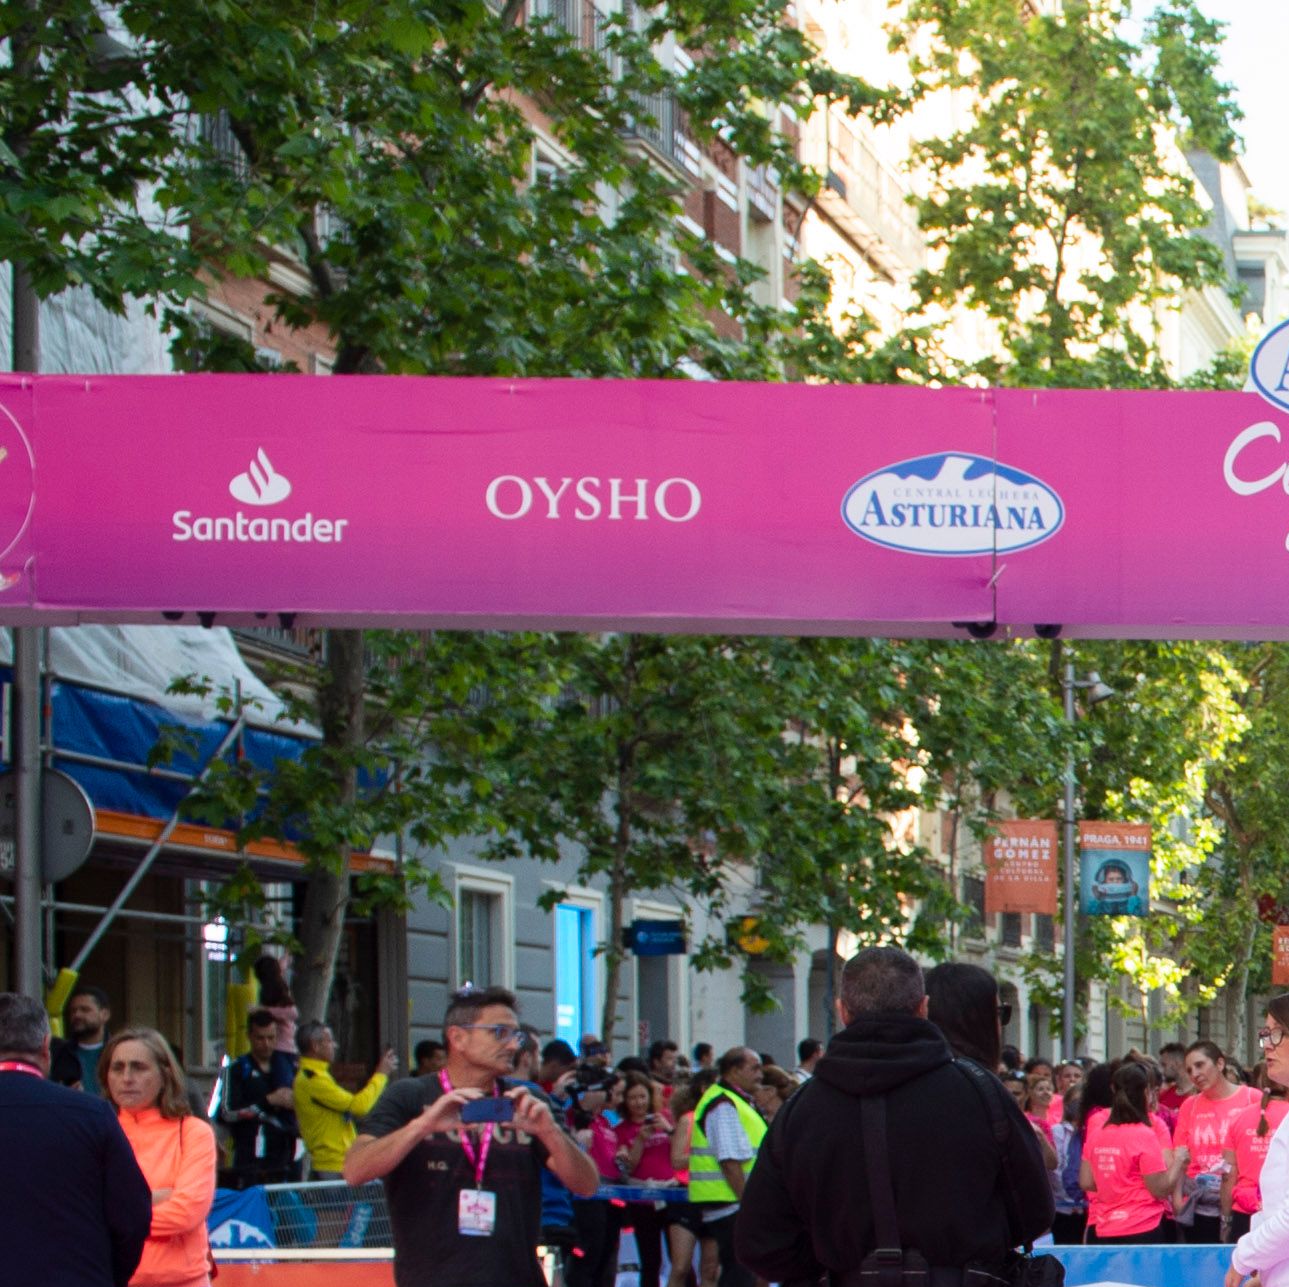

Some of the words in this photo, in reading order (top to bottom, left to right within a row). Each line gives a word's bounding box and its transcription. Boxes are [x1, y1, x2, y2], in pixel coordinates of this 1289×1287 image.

[485, 474, 702, 523] OYSHO
[860, 490, 1047, 530] ASTURIANA
[893, 487, 961, 498] CENTRAL
[968, 489, 1040, 500] LECHERA
[172, 509, 348, 544] Santander
[1083, 833, 1120, 844] PRAGA,
